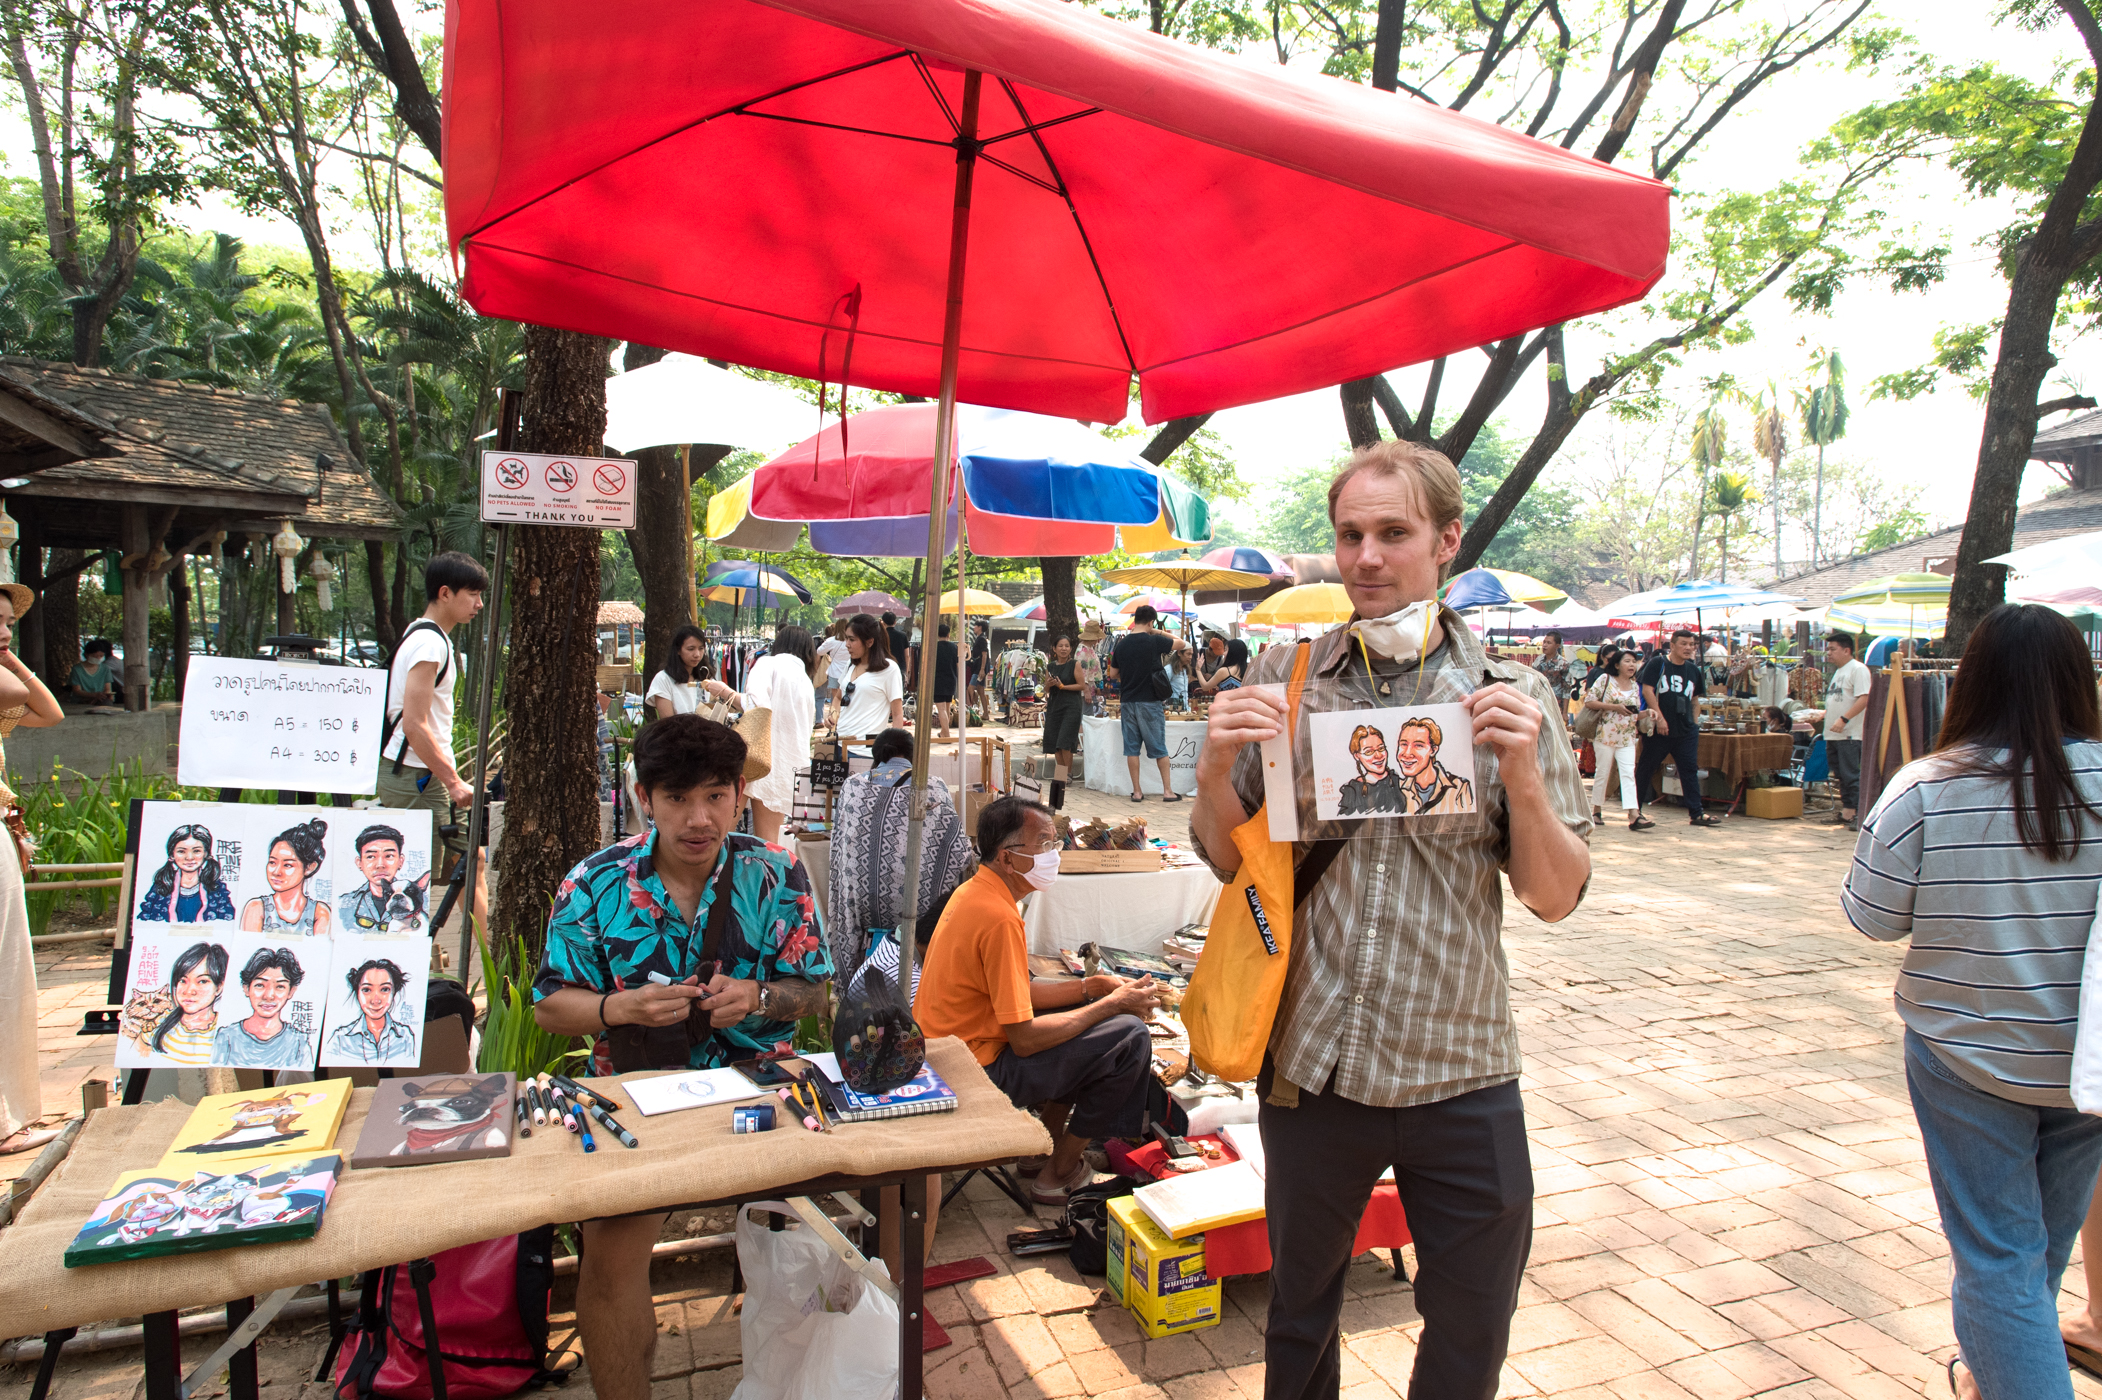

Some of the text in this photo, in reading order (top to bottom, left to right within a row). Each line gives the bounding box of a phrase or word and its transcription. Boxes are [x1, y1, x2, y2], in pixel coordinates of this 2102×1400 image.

[526, 512, 594, 522] THANK YOU
[1657, 674, 1694, 701] USA
[210, 710, 249, 722] ขนาด
[274, 717, 295, 730] A5
[319, 718, 343, 730] 150
[270, 746, 292, 760] A4
[314, 750, 340, 762] 300
[816, 762, 822, 770] 1
[815, 773, 821, 782] 7
[1248, 888, 1279, 954] IKEA FAMILY
[138, 960, 160, 970] ARE
[138, 970, 158, 978] FINE
[136, 978, 158, 987] ART
[292, 1000, 314, 1012] ARE
[291, 1012, 313, 1020] FINE
